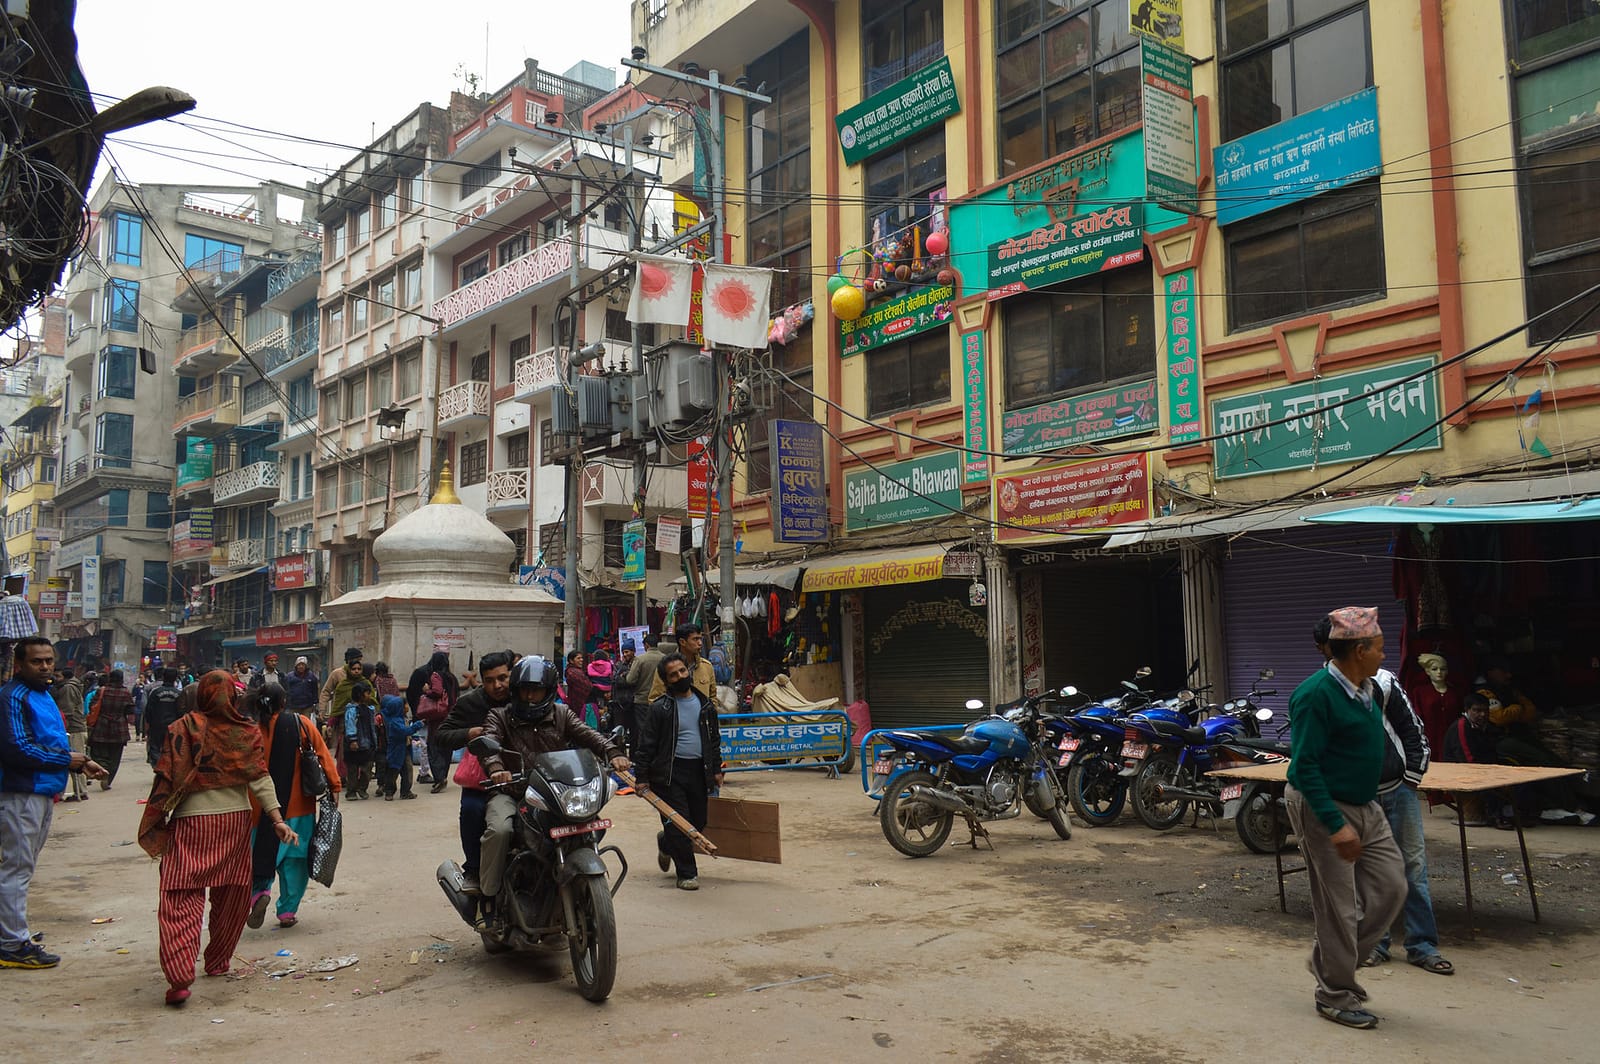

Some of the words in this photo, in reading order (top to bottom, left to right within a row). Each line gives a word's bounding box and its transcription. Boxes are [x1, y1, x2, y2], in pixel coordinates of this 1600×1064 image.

[863, 111, 877, 127] बचत
[876, 105, 888, 121] तथा
[900, 82, 924, 109] सहकारी
[923, 77, 941, 97] संस्था
[866, 125, 880, 140] SAVING
[879, 122, 890, 134] AND
[889, 113, 905, 129] CREDIT
[904, 96, 937, 121] CO-OPERATIVE
[936, 88, 955, 105] LIMITED
[1217, 168, 1229, 186] नारी
[1231, 163, 1251, 182] सहयोग
[1254, 157, 1269, 174] बचत
[1271, 152, 1284, 168] तथा
[1301, 134, 1326, 156] सहकारी
[1328, 130, 1345, 147] संस्था
[1347, 118, 1375, 141] लिमिटेड
[998, 223, 1067, 260] भोटाहिटी
[1005, 402, 1070, 429] भोटाहिटी
[1283, 388, 1350, 438] बजार
[1363, 375, 1427, 422] भवन
[783, 469, 820, 491] बुक्स
[848, 479, 877, 514] Sajha
[880, 475, 910, 503] Bazar
[912, 466, 959, 497] Bhawan
[900, 506, 930, 516] Kathmandu
[740, 745, 786, 753] WHOLESALE
[743, 725, 785, 740] बुक
[788, 722, 842, 738] हाउस
